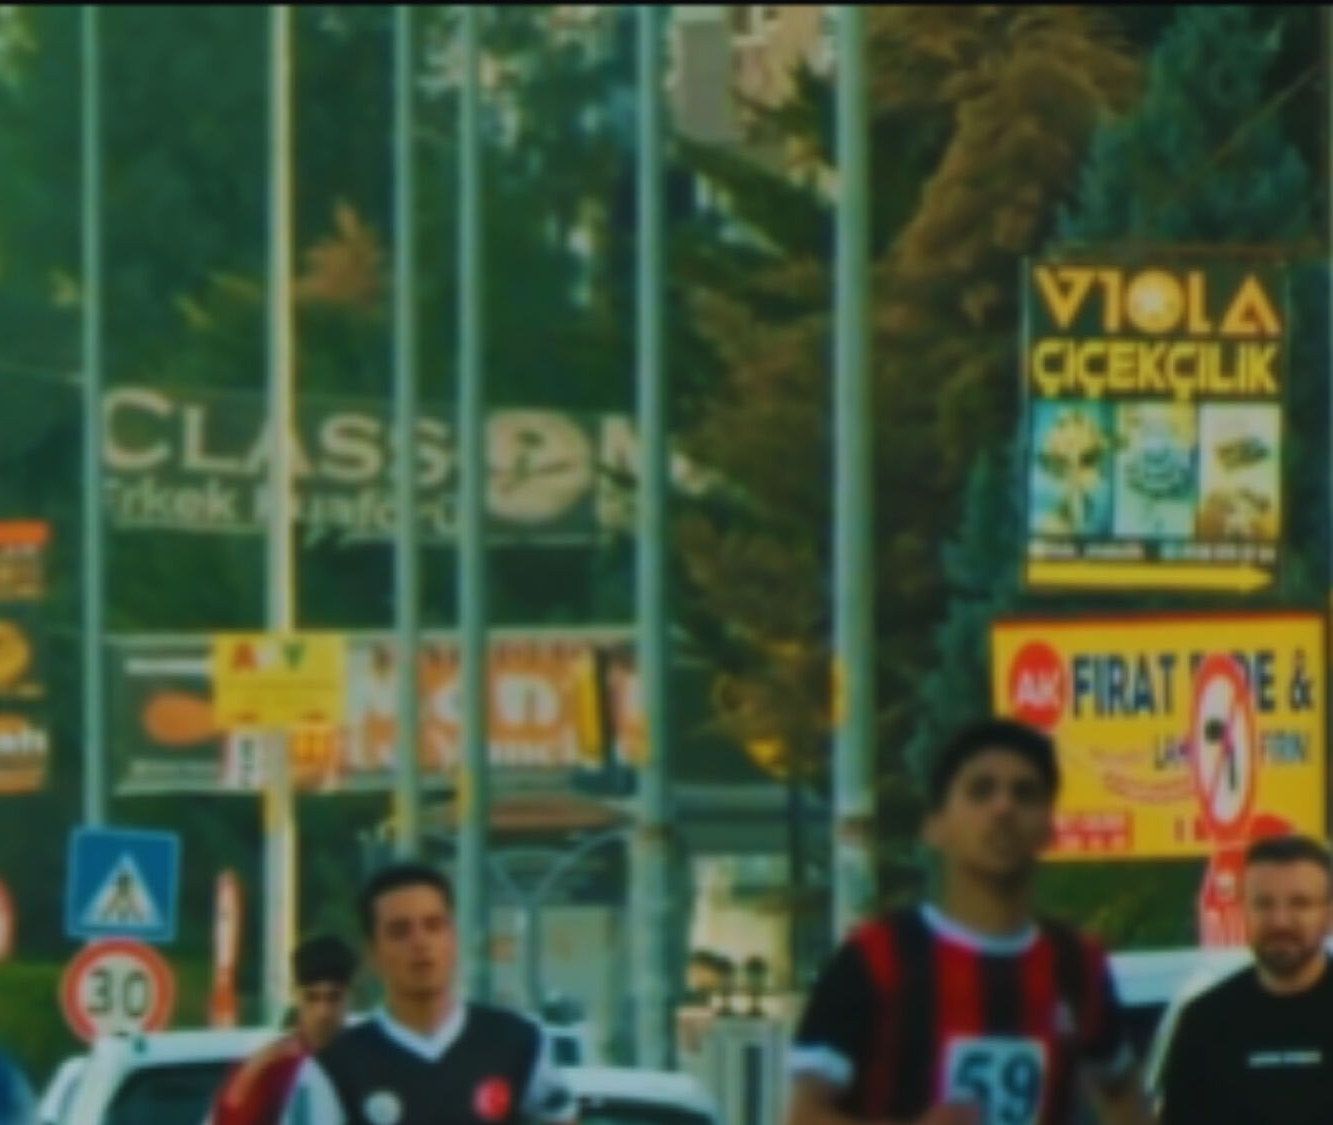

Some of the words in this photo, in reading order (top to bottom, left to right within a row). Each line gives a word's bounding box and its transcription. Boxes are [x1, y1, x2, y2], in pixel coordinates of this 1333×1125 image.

[1036, 266, 1282, 335] VIOLA
[1072, 652, 1176, 719] FIRAT
[87, 968, 149, 1019] 30
